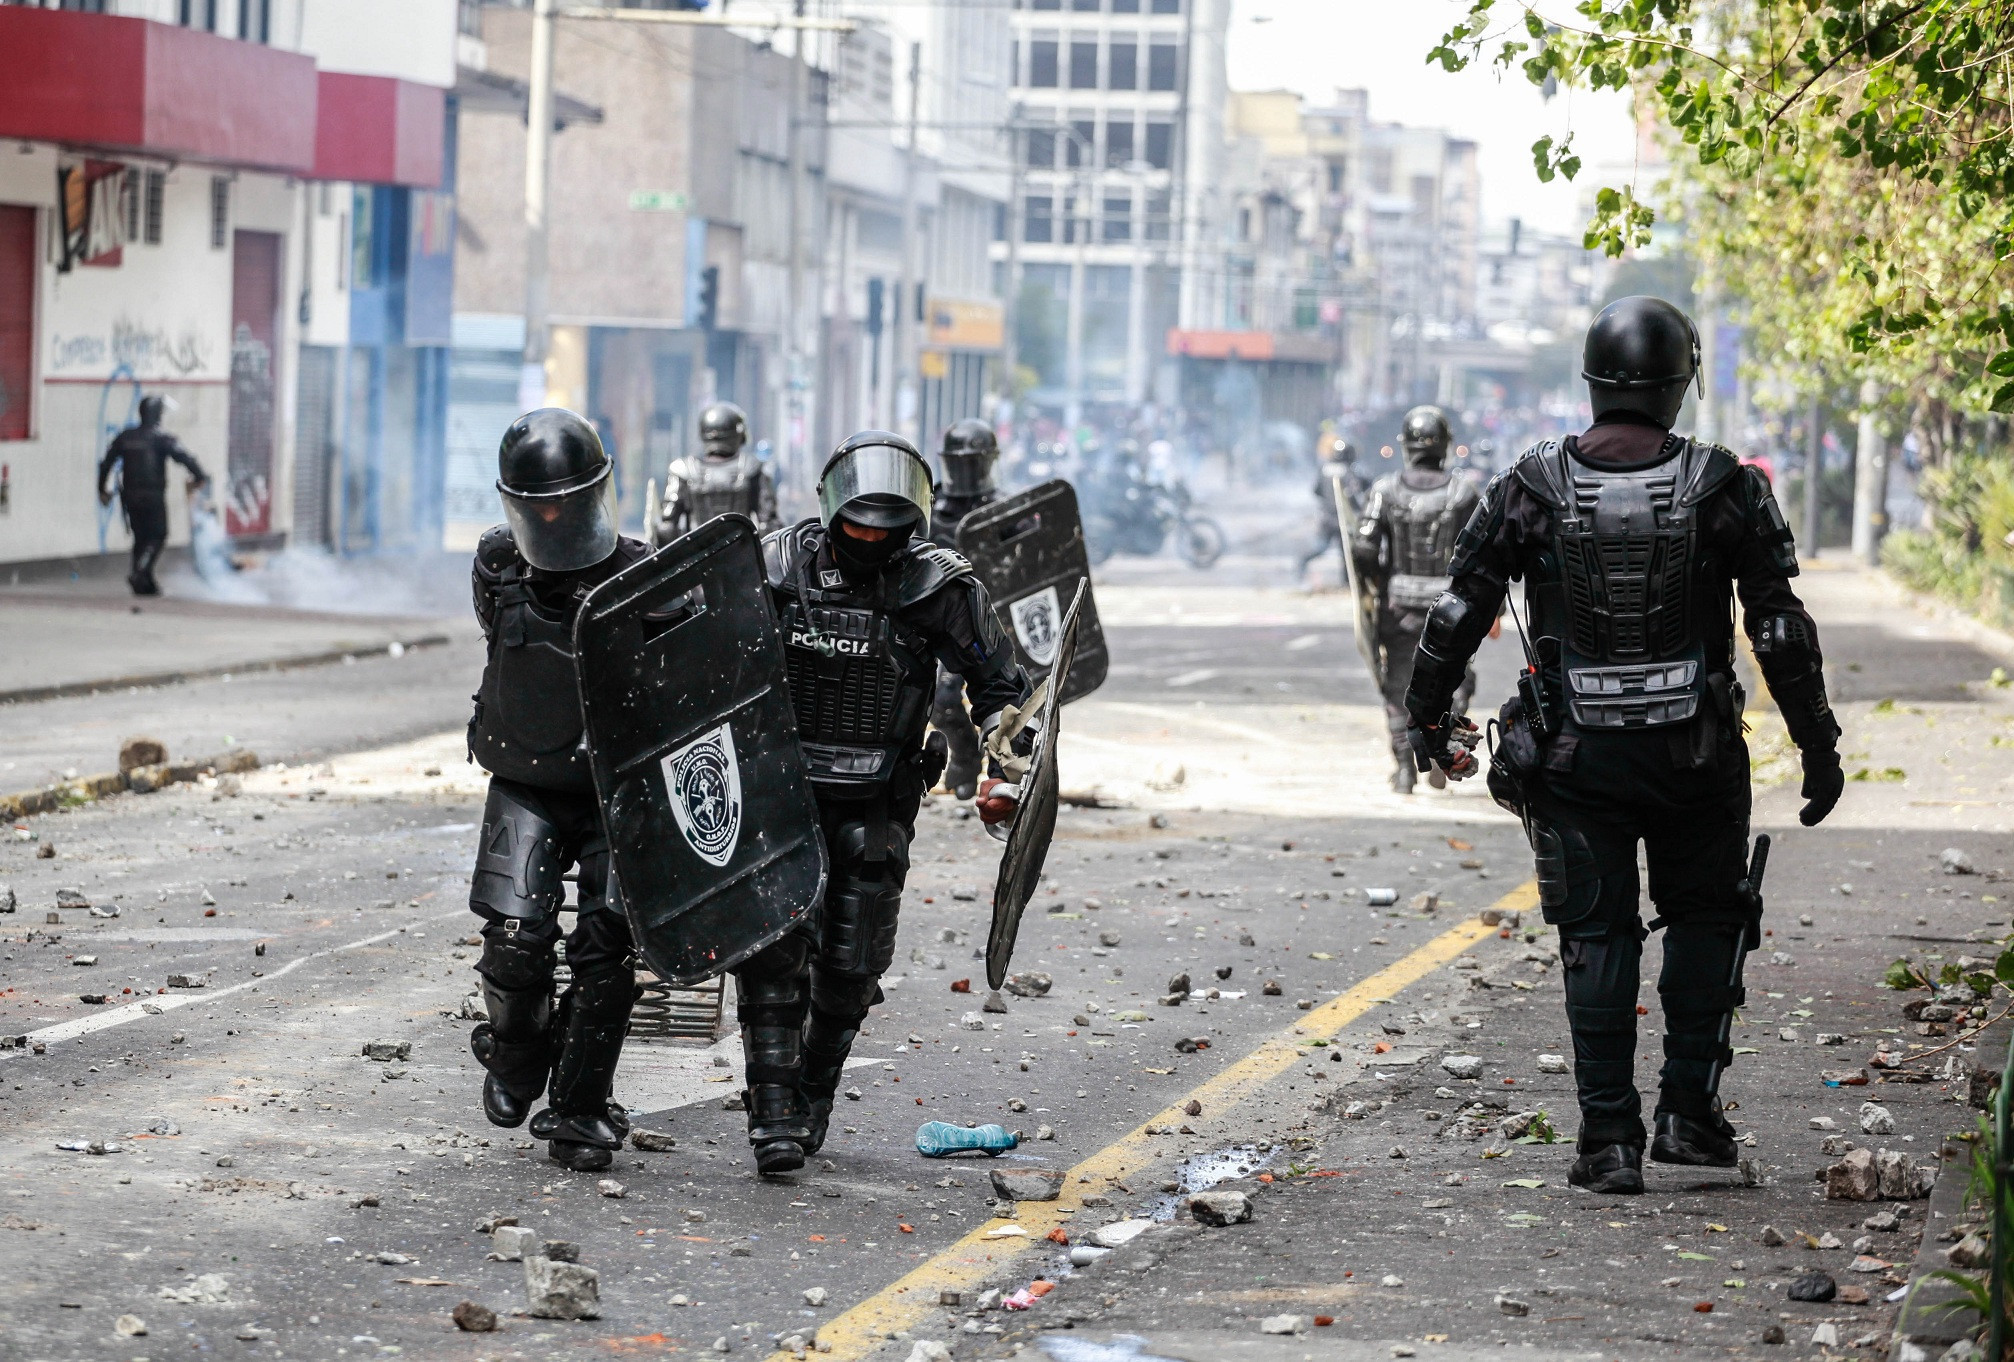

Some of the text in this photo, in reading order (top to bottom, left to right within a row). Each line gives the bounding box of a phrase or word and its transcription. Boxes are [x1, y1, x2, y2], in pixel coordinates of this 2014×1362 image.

[676, 754, 693, 788] POLICIA
[693, 746, 726, 764] NACIONAL
[694, 817, 737, 852] ANTIDISTURBIOS
